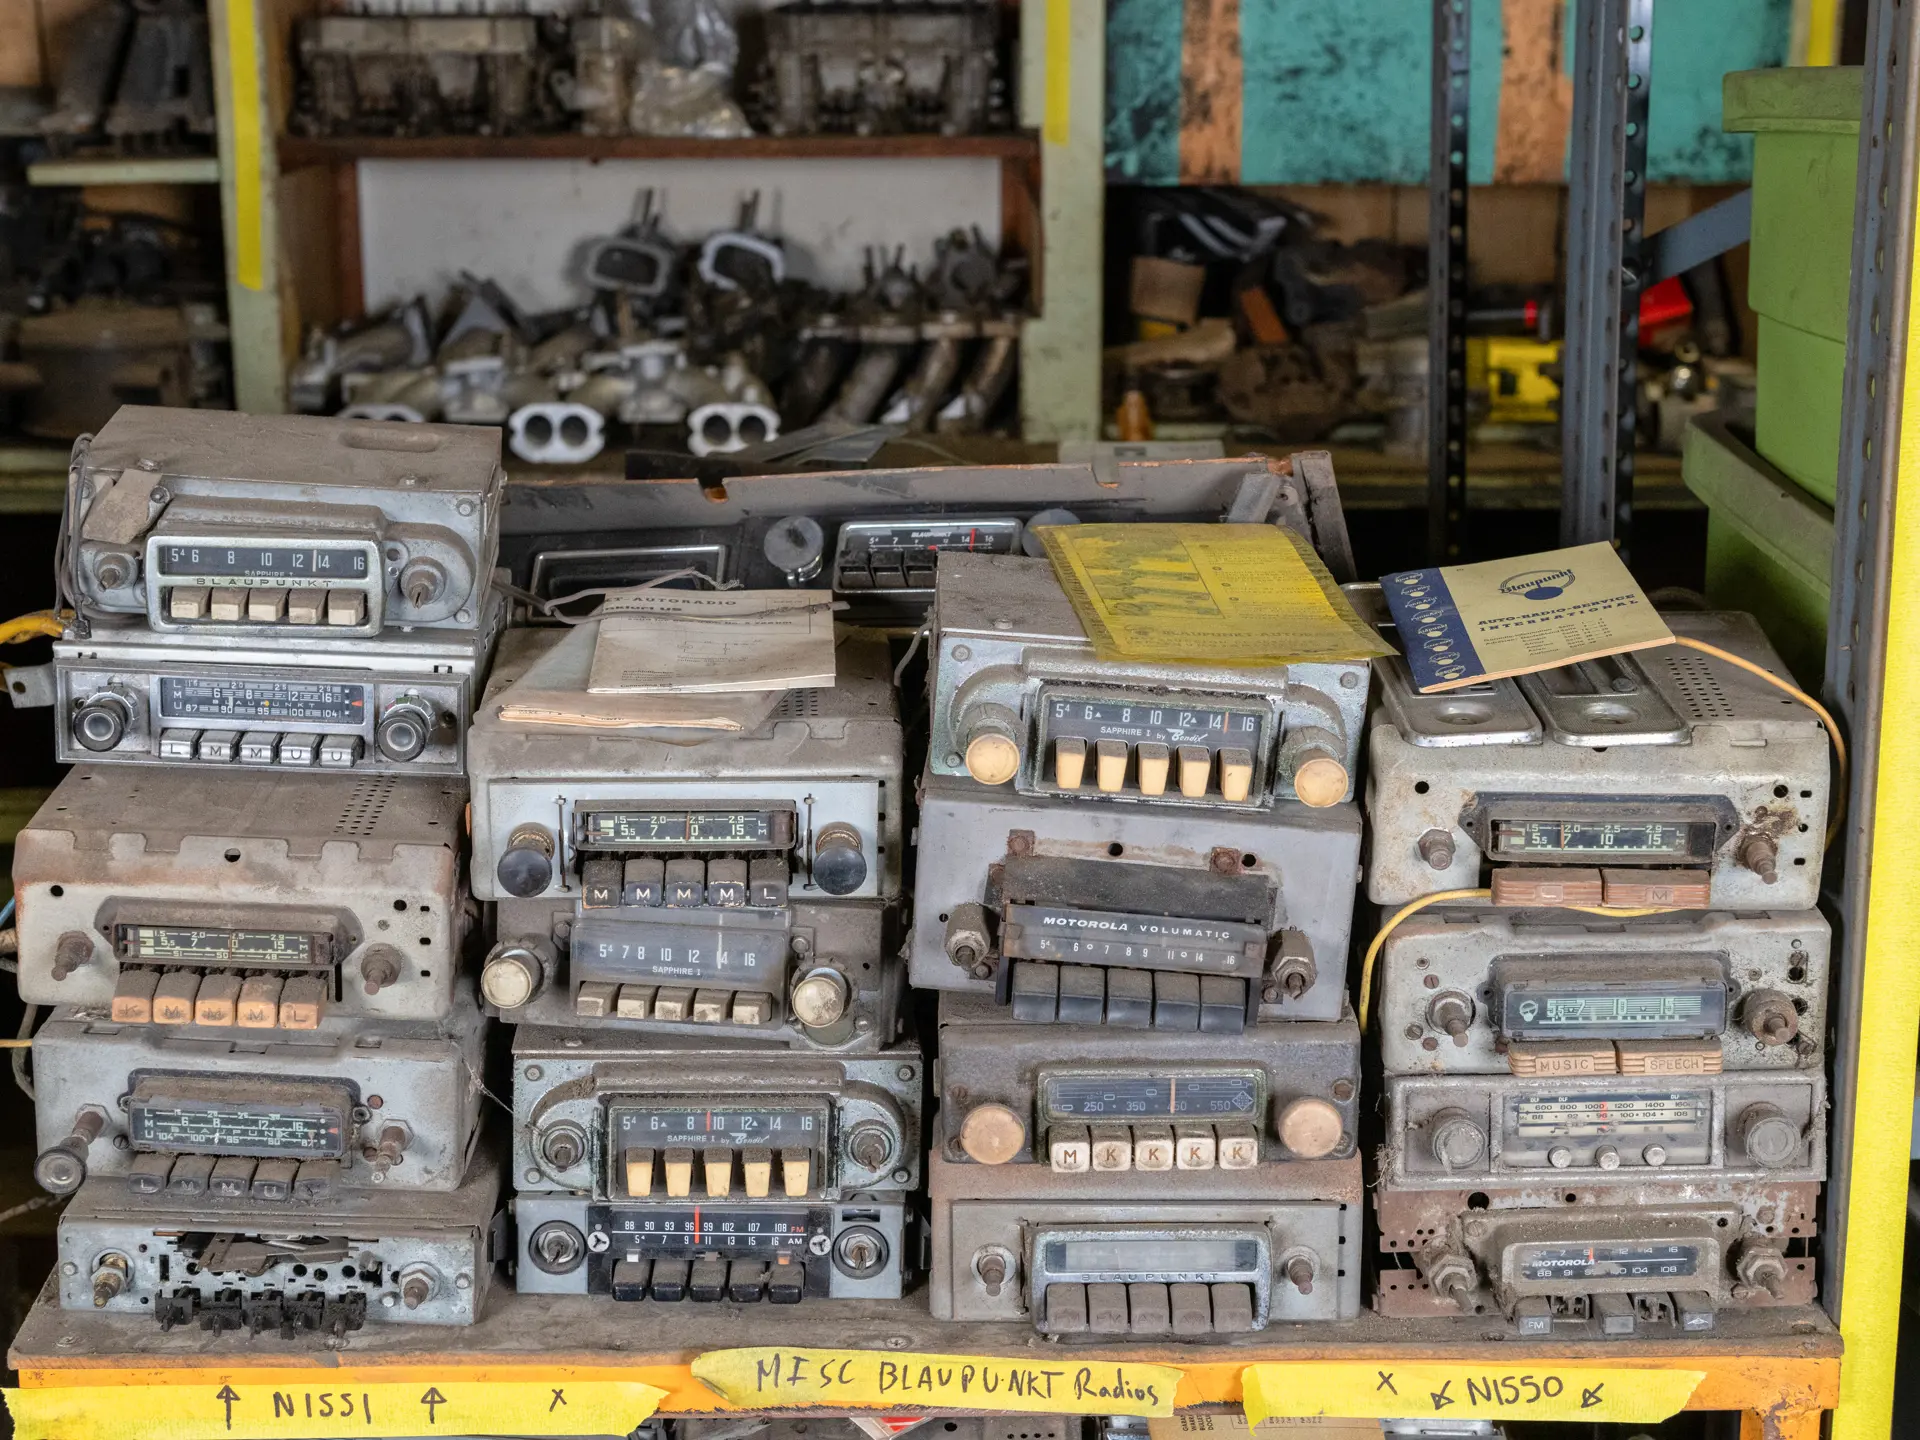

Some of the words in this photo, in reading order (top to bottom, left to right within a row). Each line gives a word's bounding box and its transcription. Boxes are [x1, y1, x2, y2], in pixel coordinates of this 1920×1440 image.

[192, 550, 199, 562] 6
[228, 551, 234, 564] 8
[261, 553, 272, 566] 10
[293, 555, 303, 567] 12
[318, 556, 330, 568] 14
[354, 557, 364, 570] 16
[197, 578, 332, 586] BLAUPUNKT
[1498, 569, 1572, 593] Blaupunkt
[1480, 600, 1638, 631] INTERNATIONAL
[213, 689, 221, 698] 6
[246, 690, 252, 699] 8
[289, 692, 298, 700] 12
[322, 693, 332, 702] 16
[186, 704, 197, 712] 87
[221, 705, 232, 713] 90
[1085, 706, 1093, 719] 6
[1123, 708, 1130, 722] 8
[1150, 711, 1162, 724] 10
[1180, 713, 1190, 726] 12
[1209, 715, 1221, 728] 14
[1242, 717, 1254, 731] 16
[1100, 726, 1142, 736] SAPPHIRE
[210, 746, 221, 756] M
[251, 748, 262, 758] M
[291, 750, 301, 759] U
[331, 752, 342, 761] U
[651, 825, 658, 835] 7
[731, 825, 744, 835] 15
[1604, 825, 1621, 833] 2.5
[1601, 834, 1613, 844] 10
[1649, 834, 1660, 844] 15
[594, 890, 608, 900] M
[636, 888, 650, 900] M
[677, 888, 691, 900] M
[720, 888, 734, 900] M
[764, 888, 776, 899] L
[1043, 917, 1128, 931] MOTOROLA
[1140, 925, 1230, 939] VOLUMATIC
[191, 939, 198, 947] 7
[274, 941, 284, 949] 15
[622, 946, 629, 959] 7
[638, 947, 645, 959] 8
[661, 949, 671, 961] 10
[689, 950, 700, 963] 12
[745, 953, 755, 966] 16
[1074, 942, 1078, 951] 6
[1196, 953, 1203, 962] 14
[1227, 955, 1235, 965] 16
[653, 967, 693, 975] SAPPHIRE
[1540, 1061, 1589, 1071] MUSIC
[1650, 1058, 1699, 1069] SPEECH
[1084, 1102, 1103, 1111] 250
[1126, 1102, 1145, 1111] 350
[1210, 1101, 1230, 1110] 550
[181, 1117, 188, 1126] 6
[259, 1120, 268, 1129] 12
[293, 1122, 303, 1131] 16
[651, 1117, 658, 1130] 6
[687, 1117, 694, 1129] 8
[714, 1117, 724, 1129] 10
[741, 1117, 752, 1130] 12
[770, 1117, 782, 1130] 14
[801, 1117, 812, 1130] 16
[1064, 1150, 1076, 1163] M
[1107, 1149, 1116, 1160] K
[1149, 1149, 1159, 1160] K
[1190, 1148, 1200, 1159] K
[1233, 1147, 1242, 1158] K
[624, 1221, 634, 1231] 88
[645, 1222, 654, 1231] 90
[665, 1222, 674, 1231] 93
[685, 1222, 694, 1231] 96
[704, 1222, 713, 1232] 99
[722, 1223, 734, 1232] 102
[774, 1223, 787, 1232] 108
[662, 1235, 667, 1244] 7
[684, 1235, 689, 1244] 9
[705, 1235, 711, 1245] 11
[727, 1236, 735, 1245] 13
[749, 1236, 756, 1246] 15
[772, 1236, 779, 1246] 16
[1532, 1259, 1595, 1267] MOTOROLA
[1081, 1273, 1219, 1281] BLAUPUNKT
[756, 1353, 855, 1392] MISC
[1073, 1369, 1160, 1405] Radios
